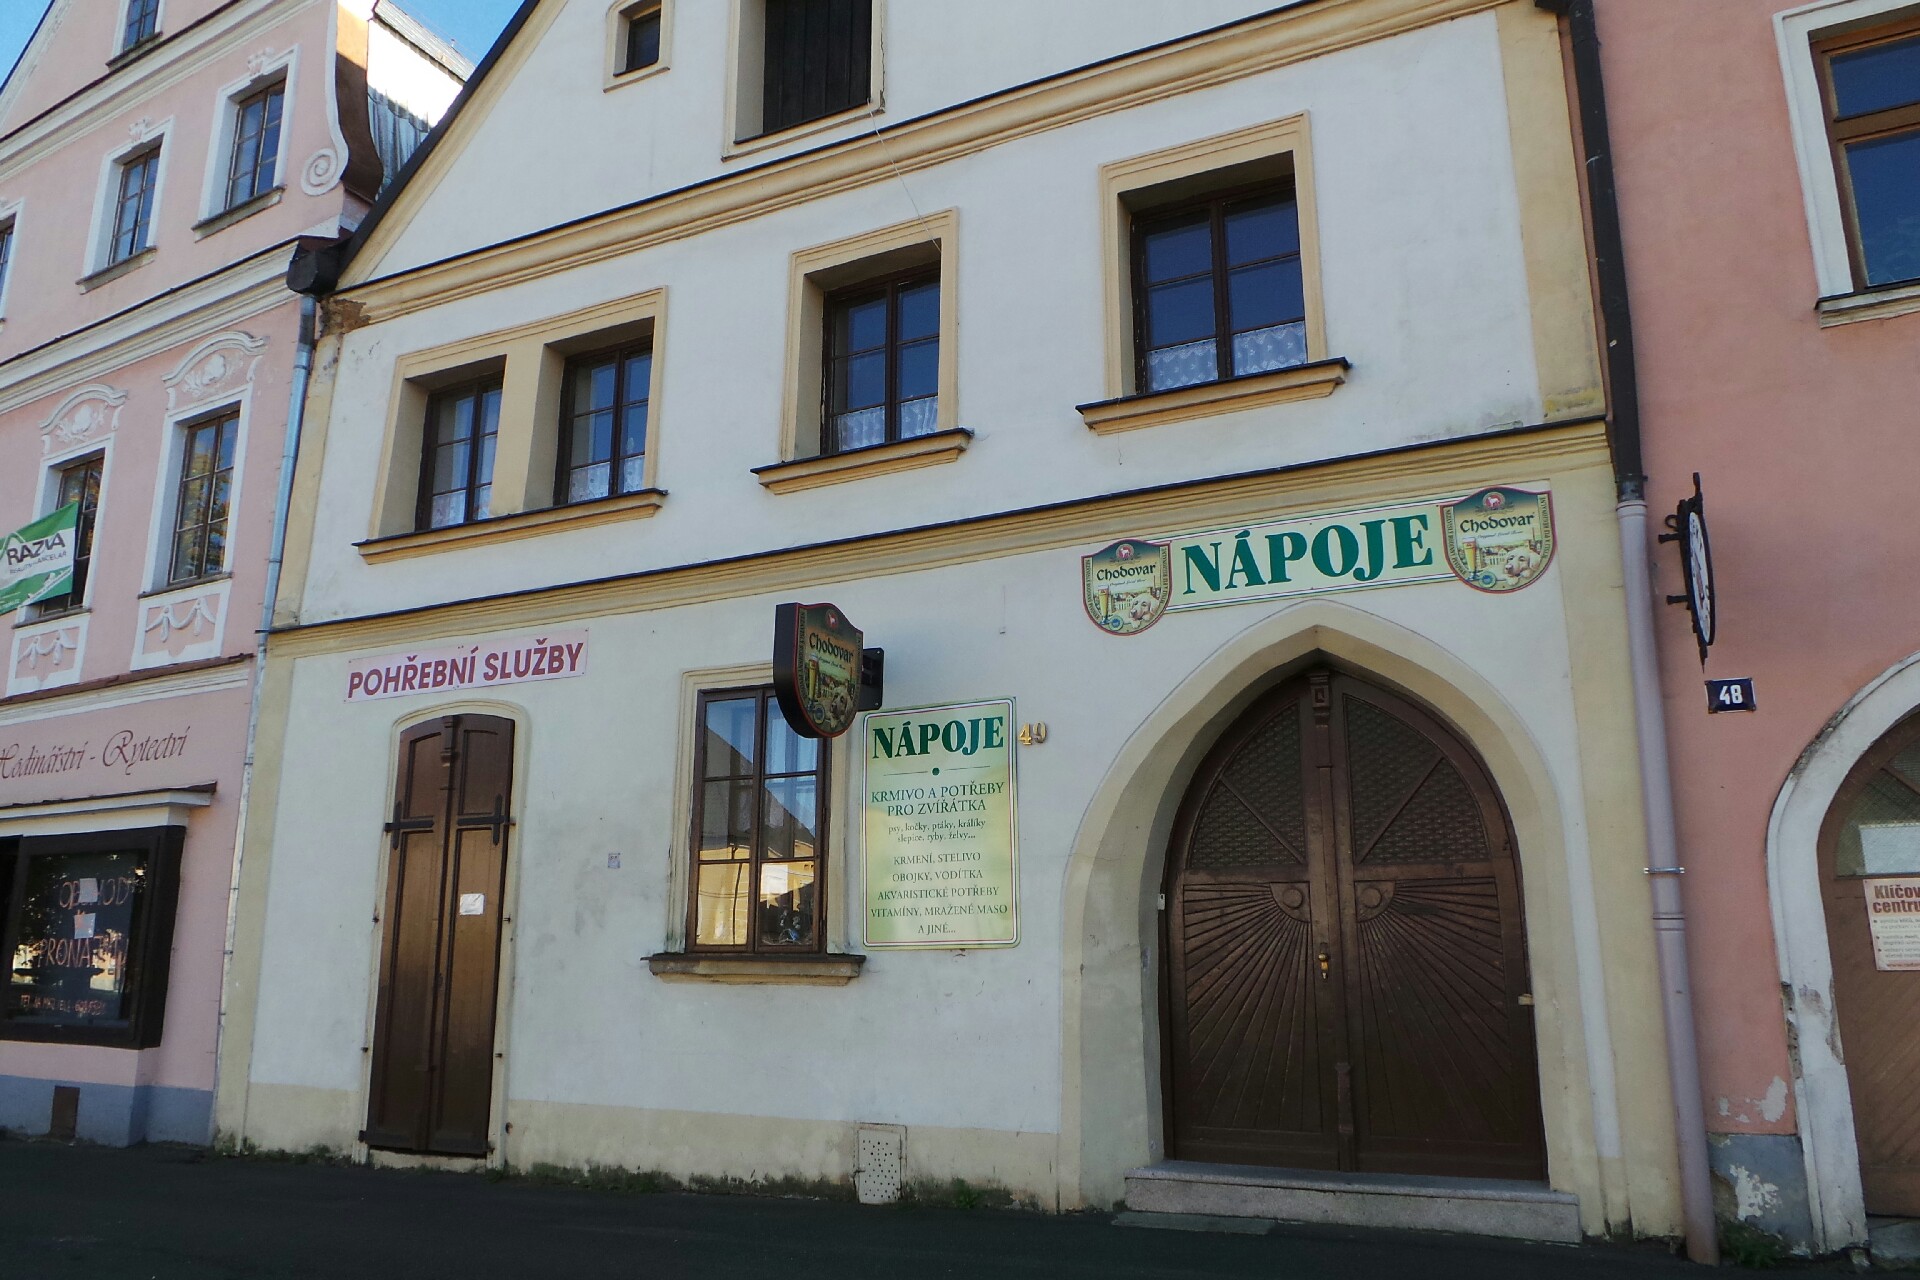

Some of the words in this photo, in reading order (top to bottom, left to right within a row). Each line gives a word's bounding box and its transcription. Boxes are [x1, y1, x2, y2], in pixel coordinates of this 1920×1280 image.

[1460, 514, 1535, 533] Chodovar
[1181, 513, 1434, 595] NÁPOJE
[1097, 563, 1156, 581] Chodovar
[808, 632, 854, 663] Chodovar
[347, 645, 479, 699] POHŘEBNÍ
[483, 637, 584, 681] SLUŽBY
[1719, 685, 1743, 704] 48
[872, 716, 1004, 759] NÁPOJE
[1019, 720, 1048, 746] 49
[102, 725, 191, 776] Rytectví
[871, 787, 925, 803] KRMIVO
[928, 787, 937, 799] A
[941, 780, 1005, 798] POTŘEBY
[887, 804, 914, 816] PRO
[918, 798, 986, 815] ZVÍŘÁTKA
[905, 821, 930, 832] kočky,
[932, 819, 956, 831] ptáky,
[958, 817, 986, 829] králíky
[894, 853, 935, 866] KRMENÍ,
[937, 852, 981, 863] STELIVO
[892, 871, 933, 883] OBOJKY,
[935, 868, 983, 881] VODÍTKA
[877, 887, 949, 900] AKVARISTICKÉ
[951, 884, 1000, 898] POTŘEBY
[870, 905, 922, 918] VITAMÍNY,
[924, 903, 974, 916] MRAŽENÉ
[977, 904, 1008, 915] MASO
[918, 925, 925, 934] A
[926, 922, 956, 936] JINÉ...
